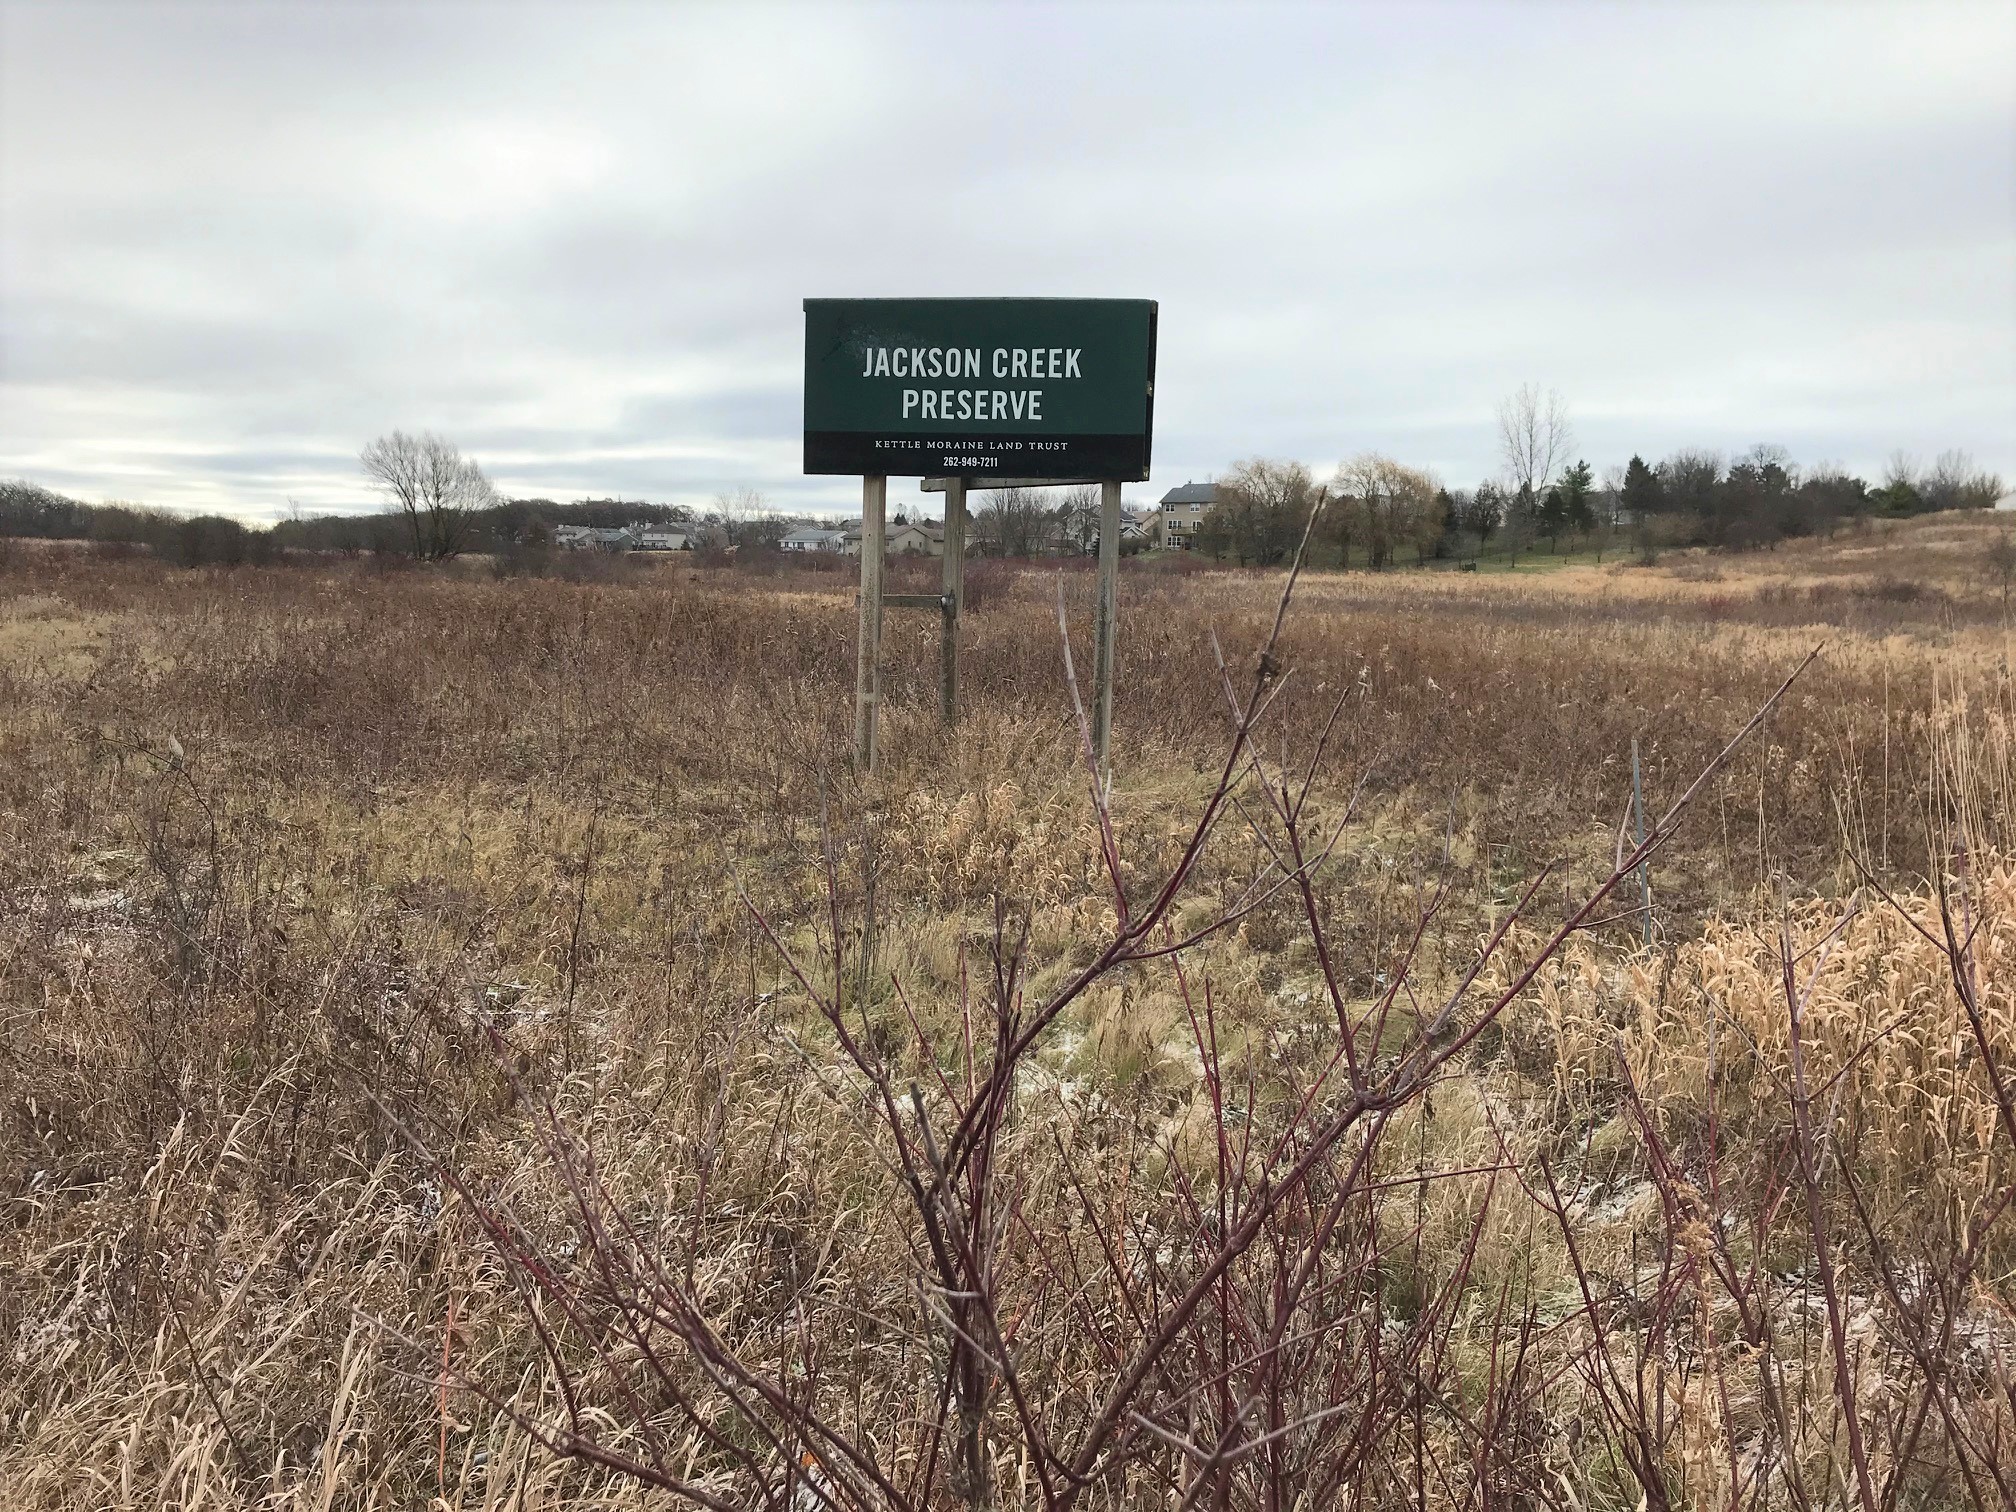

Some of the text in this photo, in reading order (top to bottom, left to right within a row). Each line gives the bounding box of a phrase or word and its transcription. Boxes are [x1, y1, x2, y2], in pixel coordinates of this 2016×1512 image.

[862, 347, 1082, 378] JACKSON CREEK
[902, 389, 1043, 421] PRESERVE
[875, 440, 1069, 451] KETTLE MORAINE LAND TRUST
[943, 456, 998, 468] 262-949-7211
